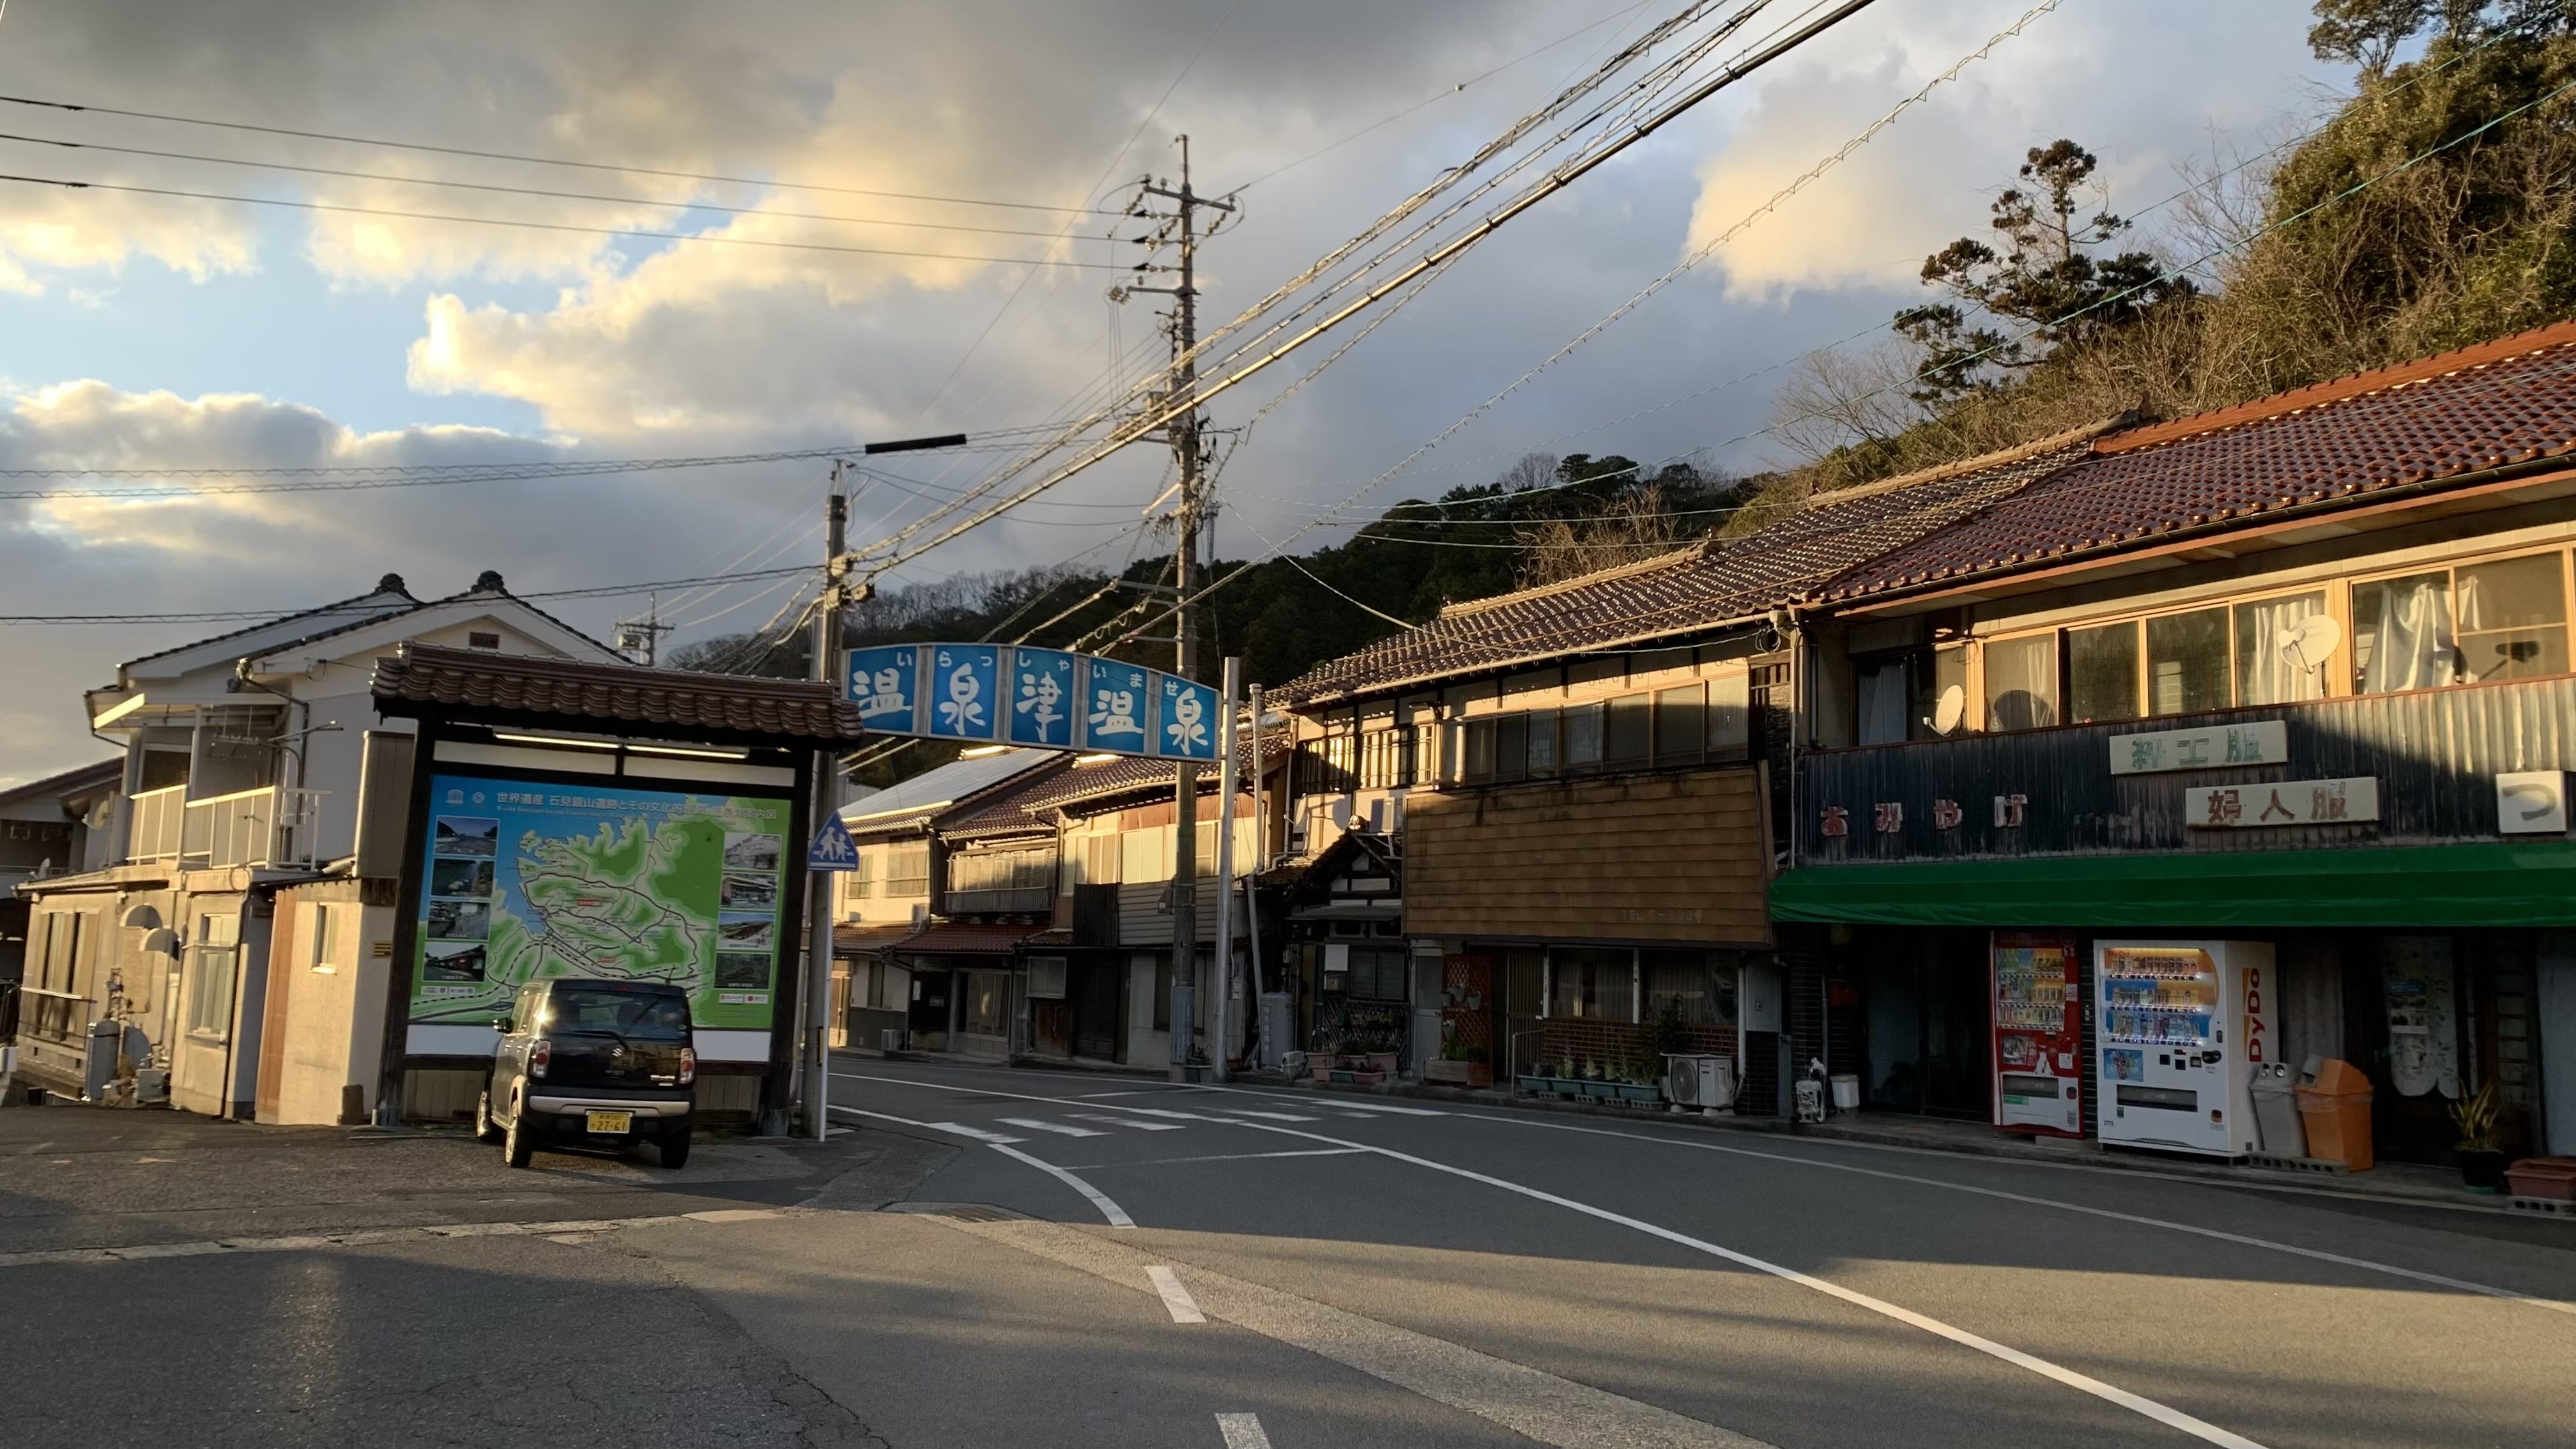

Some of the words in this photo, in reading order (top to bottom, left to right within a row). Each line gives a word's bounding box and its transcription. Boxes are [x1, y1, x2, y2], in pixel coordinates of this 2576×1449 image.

[896, 650, 1178, 696] いらっしゃいませ
[853, 663, 1209, 756] 温泉津温泉
[496, 792, 545, 806] 世界遺産
[2208, 781, 2349, 824] 婦人服
